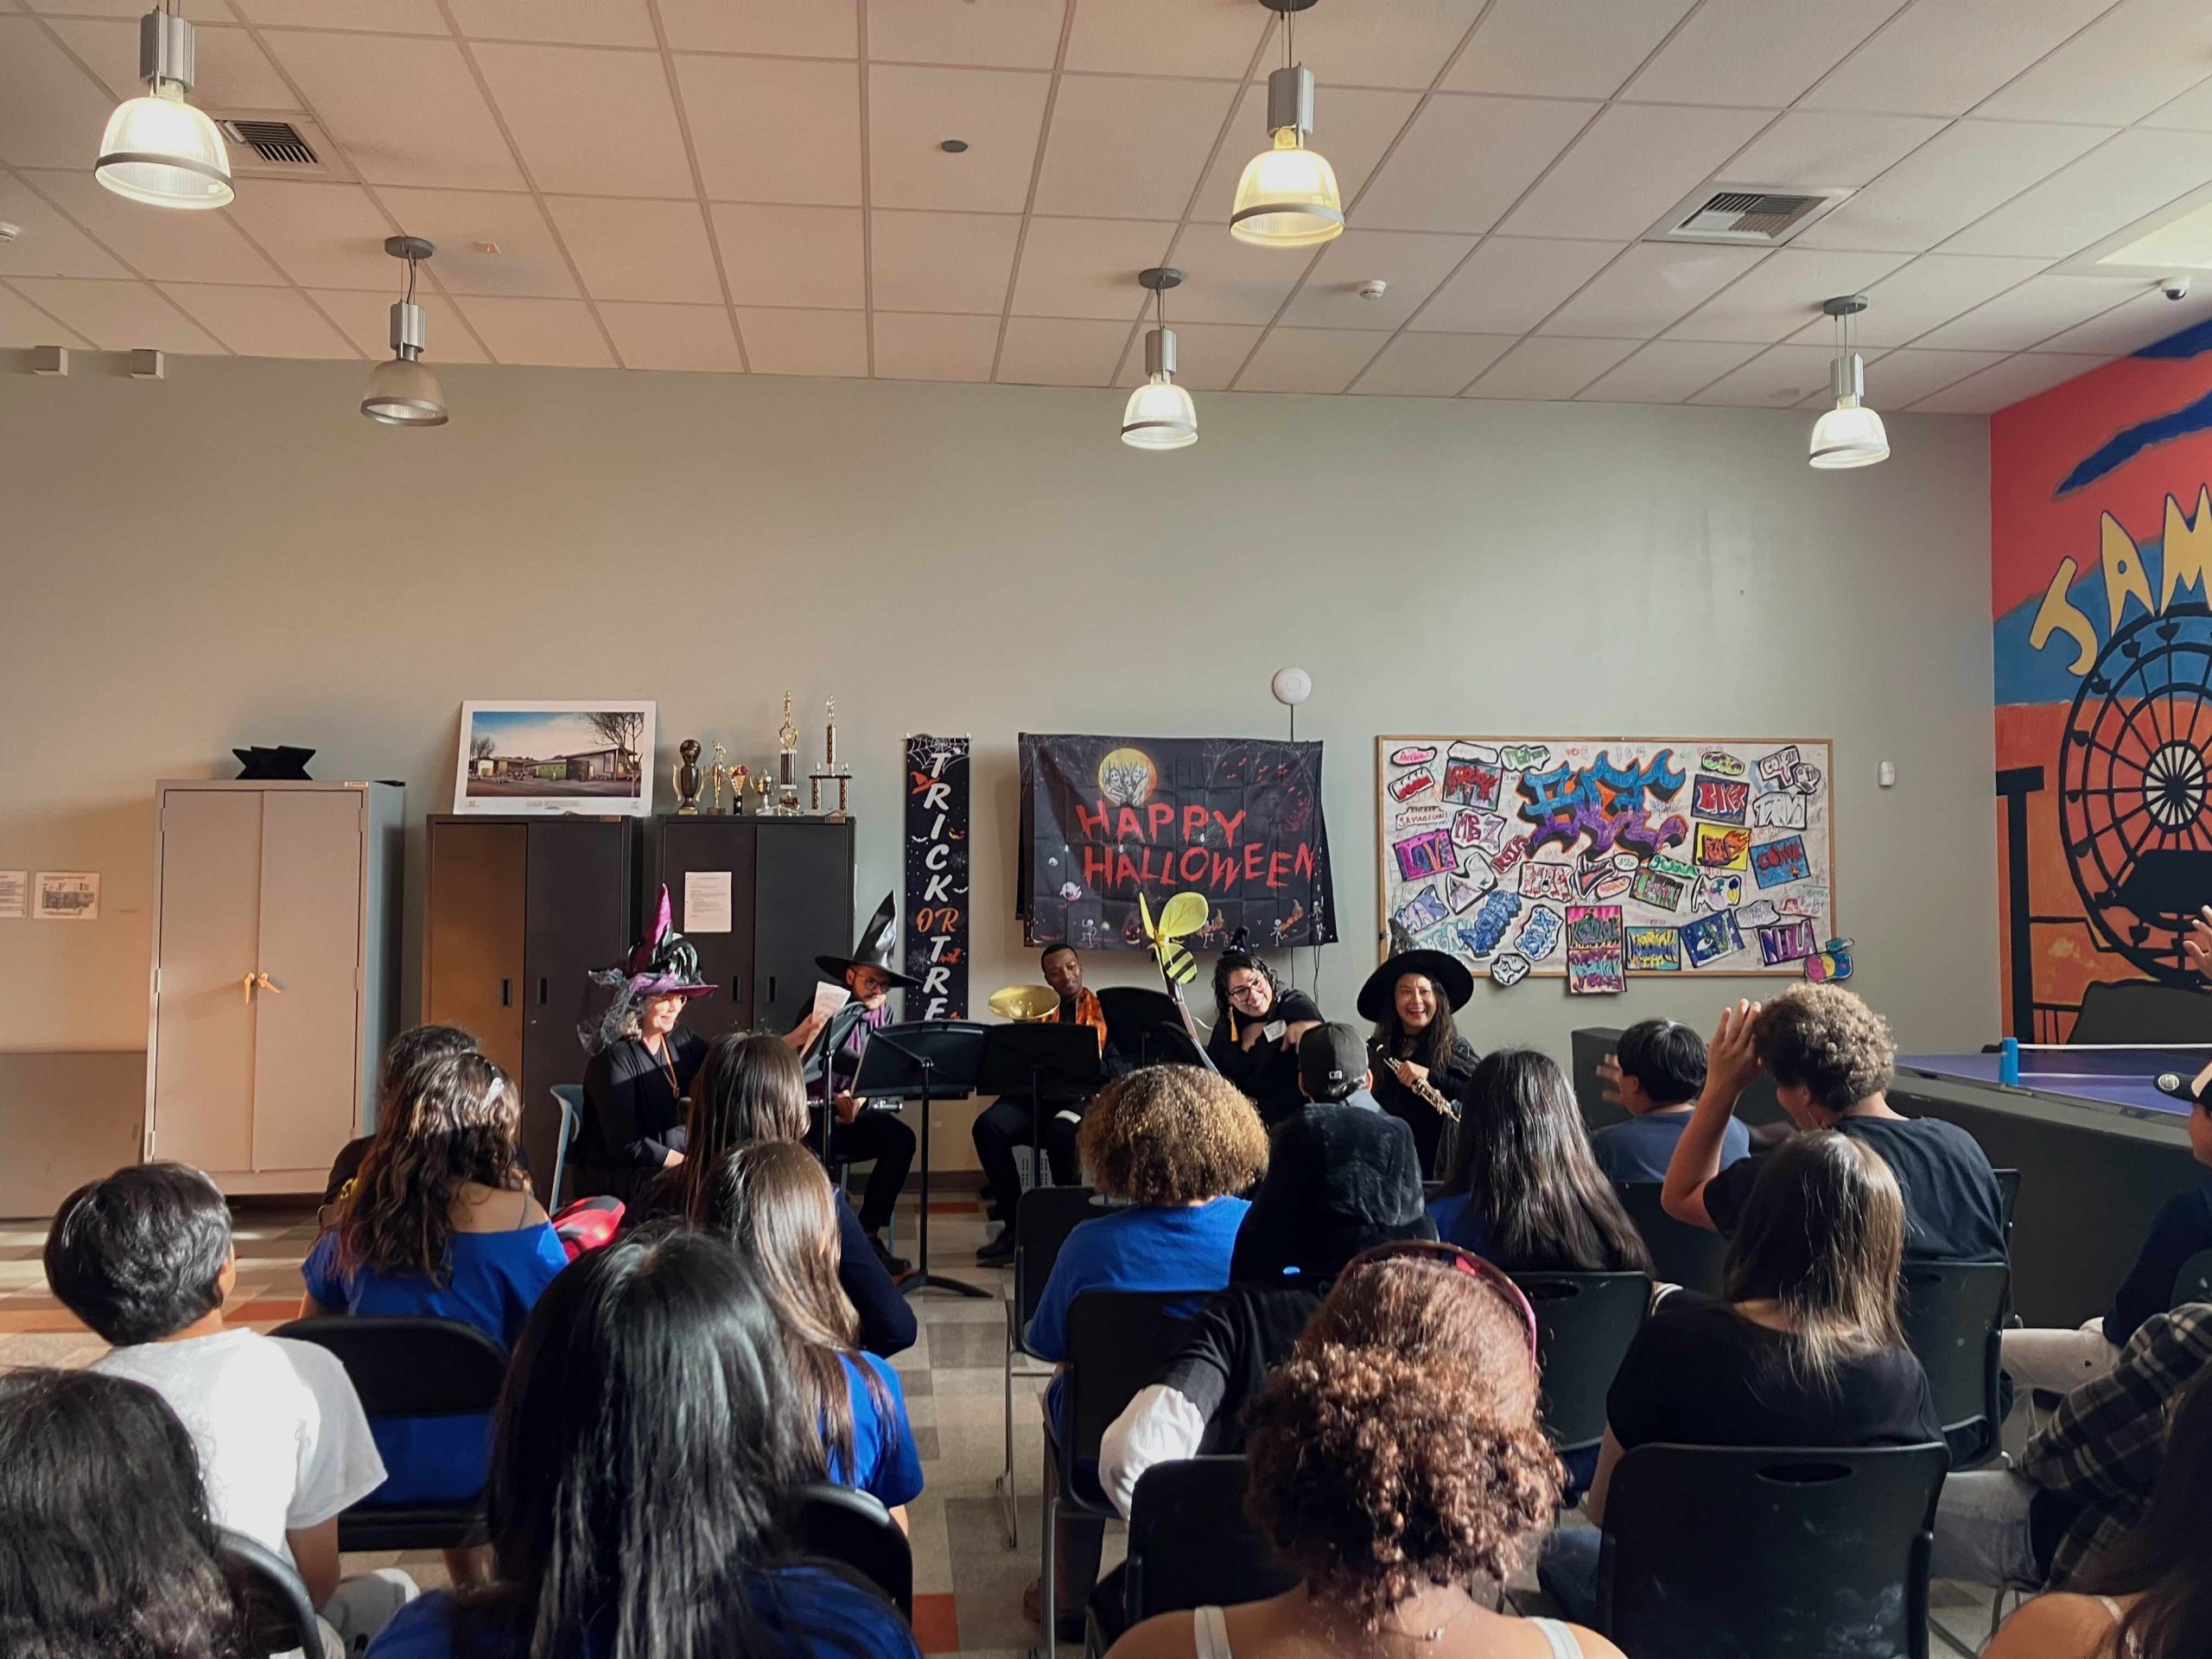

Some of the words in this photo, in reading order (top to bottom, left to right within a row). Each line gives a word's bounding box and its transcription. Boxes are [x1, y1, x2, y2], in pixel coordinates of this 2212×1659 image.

[923, 753, 952, 901] TRICK
[1075, 799, 1246, 849] HAPPY
[1084, 842, 1315, 892] HALLOWEEN
[916, 907, 959, 932] OR
